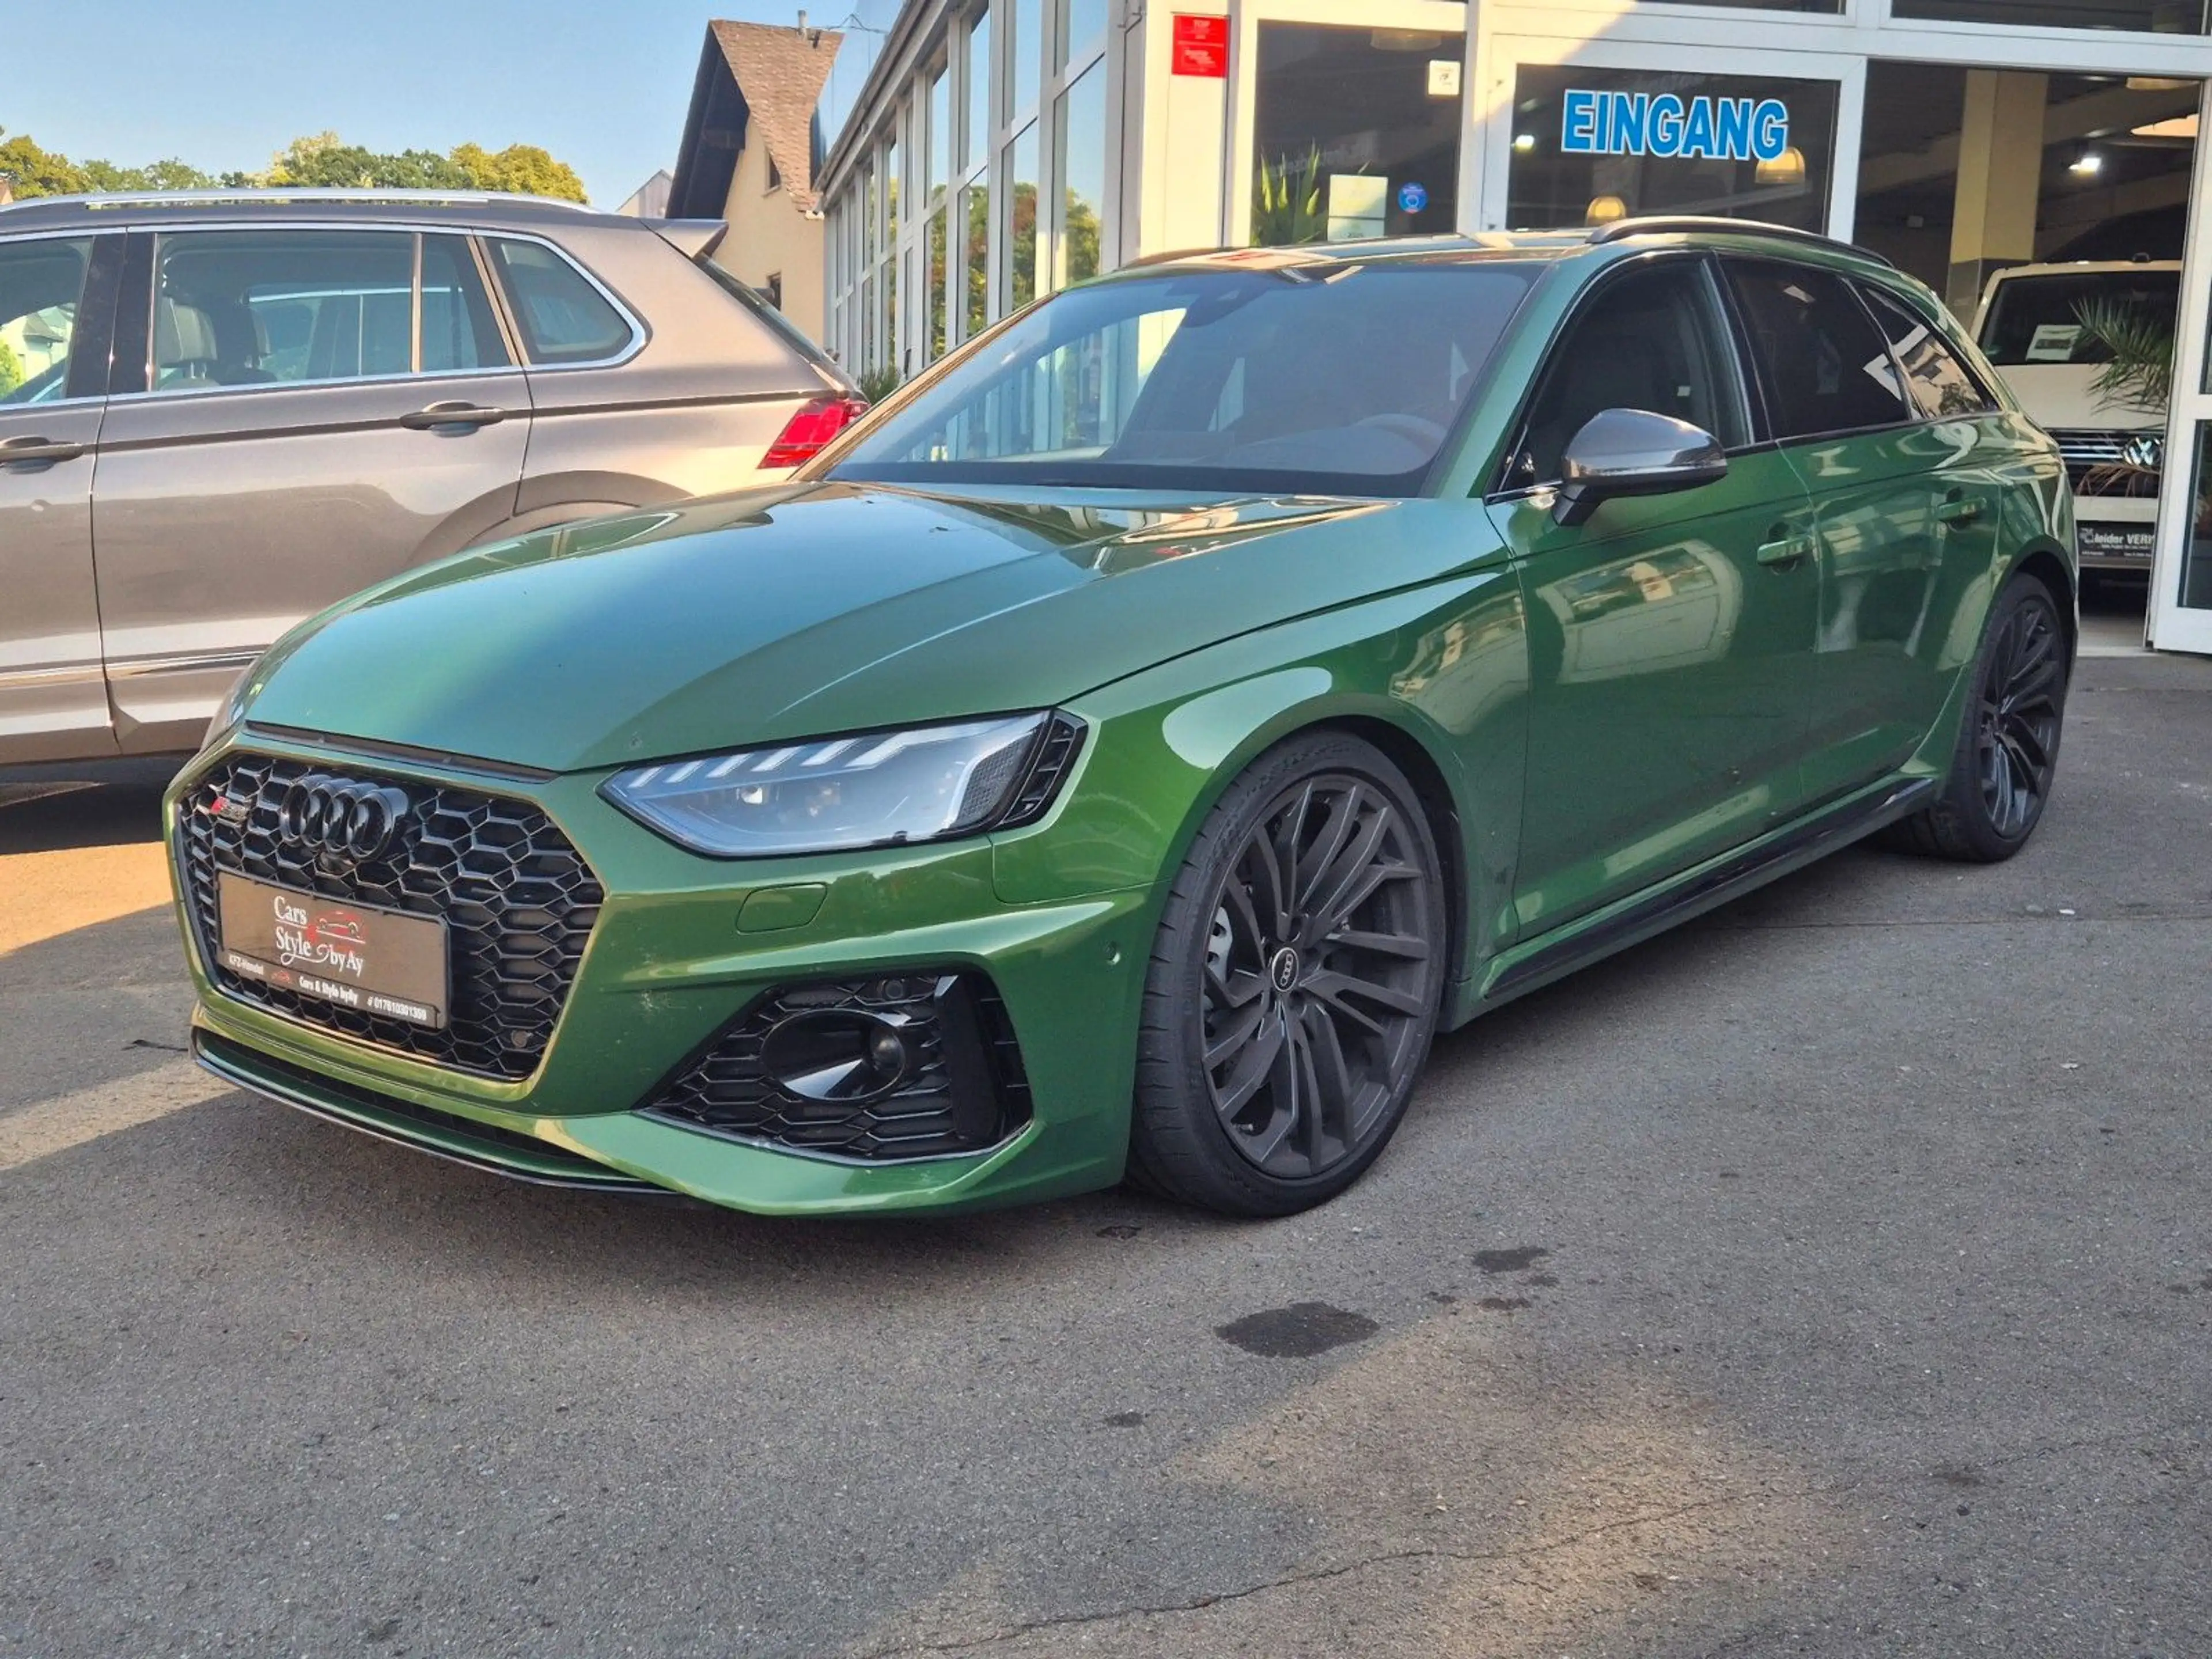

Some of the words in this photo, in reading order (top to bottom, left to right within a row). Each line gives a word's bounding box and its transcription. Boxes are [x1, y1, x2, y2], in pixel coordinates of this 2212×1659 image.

[1562, 89, 1789, 161] EINGANG
[274, 896, 308, 925] Cars
[276, 926, 315, 965] Style
